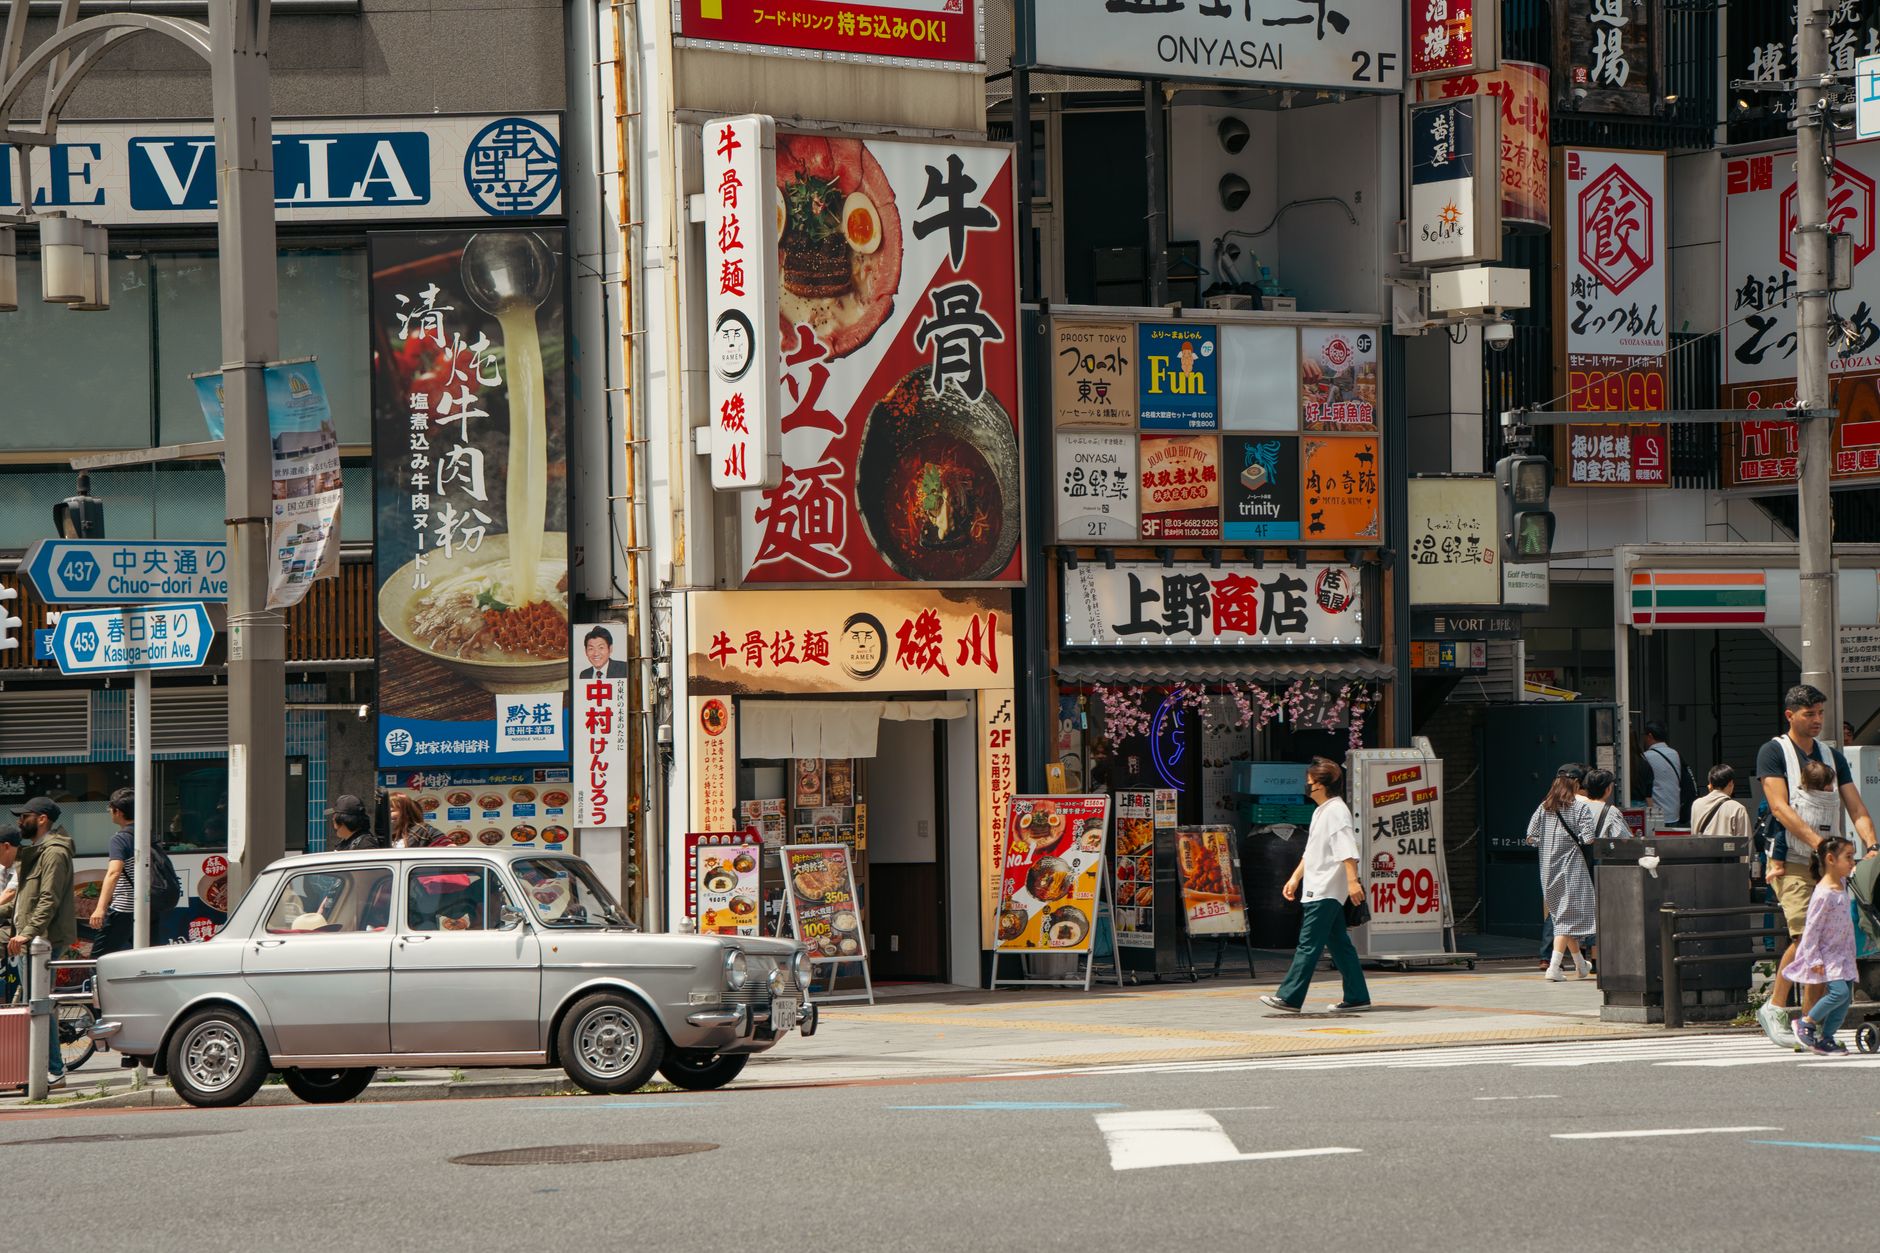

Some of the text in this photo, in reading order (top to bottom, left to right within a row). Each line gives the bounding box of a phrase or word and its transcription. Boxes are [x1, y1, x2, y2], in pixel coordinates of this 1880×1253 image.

[753, 8, 947, 43] フード・ドリンク 持ち込みOK!
[1157, 35, 1283, 70] ONYASAI
[1351, 51, 1397, 83] 2F
[136, 138, 423, 206] VLA
[1567, 152, 1588, 181] 2F
[1727, 155, 1773, 195] 2階
[1585, 183, 1646, 269] 餃
[913, 154, 1004, 401] 牛骨
[1571, 273, 1603, 300] 肉汁
[1734, 269, 1797, 311] 肉汁
[1098, 333, 1127, 344] TOKYO
[1356, 337, 1372, 350] 9F
[1619, 338, 1664, 347] GYOZA SAKABA
[1147, 355, 1207, 395] Fun
[1627, 356, 1664, 368] ハイボール
[1830, 356, 1872, 369] GYOZA
[1076, 378, 1112, 405] 東京
[720, 392, 750, 481] 磯川
[1074, 453, 1117, 464] ONYASAI
[1147, 446, 1208, 468] JOJO OLD HOT POT
[1064, 466, 1129, 501] 温野菜
[1572, 460, 1631, 482] 個室完備
[409, 392, 432, 590] 塩煮込み牛肉ヌードル
[1239, 501, 1281, 519] trinity
[1087, 521, 1107, 536] 2F
[1142, 519, 1161, 536] 3F
[1254, 524, 1268, 537] 4F
[112, 548, 226, 575] 中央通り
[1411, 533, 1482, 565] 温野菜
[63, 561, 94, 581] 437
[107, 576, 192, 595] Chuo-dori
[1317, 570, 1345, 610] 居酒屋
[1111, 572, 1308, 636] 上野商店
[107, 613, 188, 641] 春日通り
[1449, 618, 1485, 632] VORT
[73, 631, 96, 652] 453
[104, 640, 193, 664] Kasuga-dori Ave.
[895, 608, 999, 678] 磯川
[850, 653, 875, 661] RAMEN
[989, 728, 1012, 749] 2F
[585, 680, 613, 825] 中村けんじろう
[991, 753, 1002, 870] ご用意しております
[1119, 794, 1151, 807] 上野商店
[1372, 807, 1430, 841] 大感謝
[1397, 838, 1437, 855] SALE
[824, 891, 850, 904] 350円
[803, 922, 831, 938] 100円
